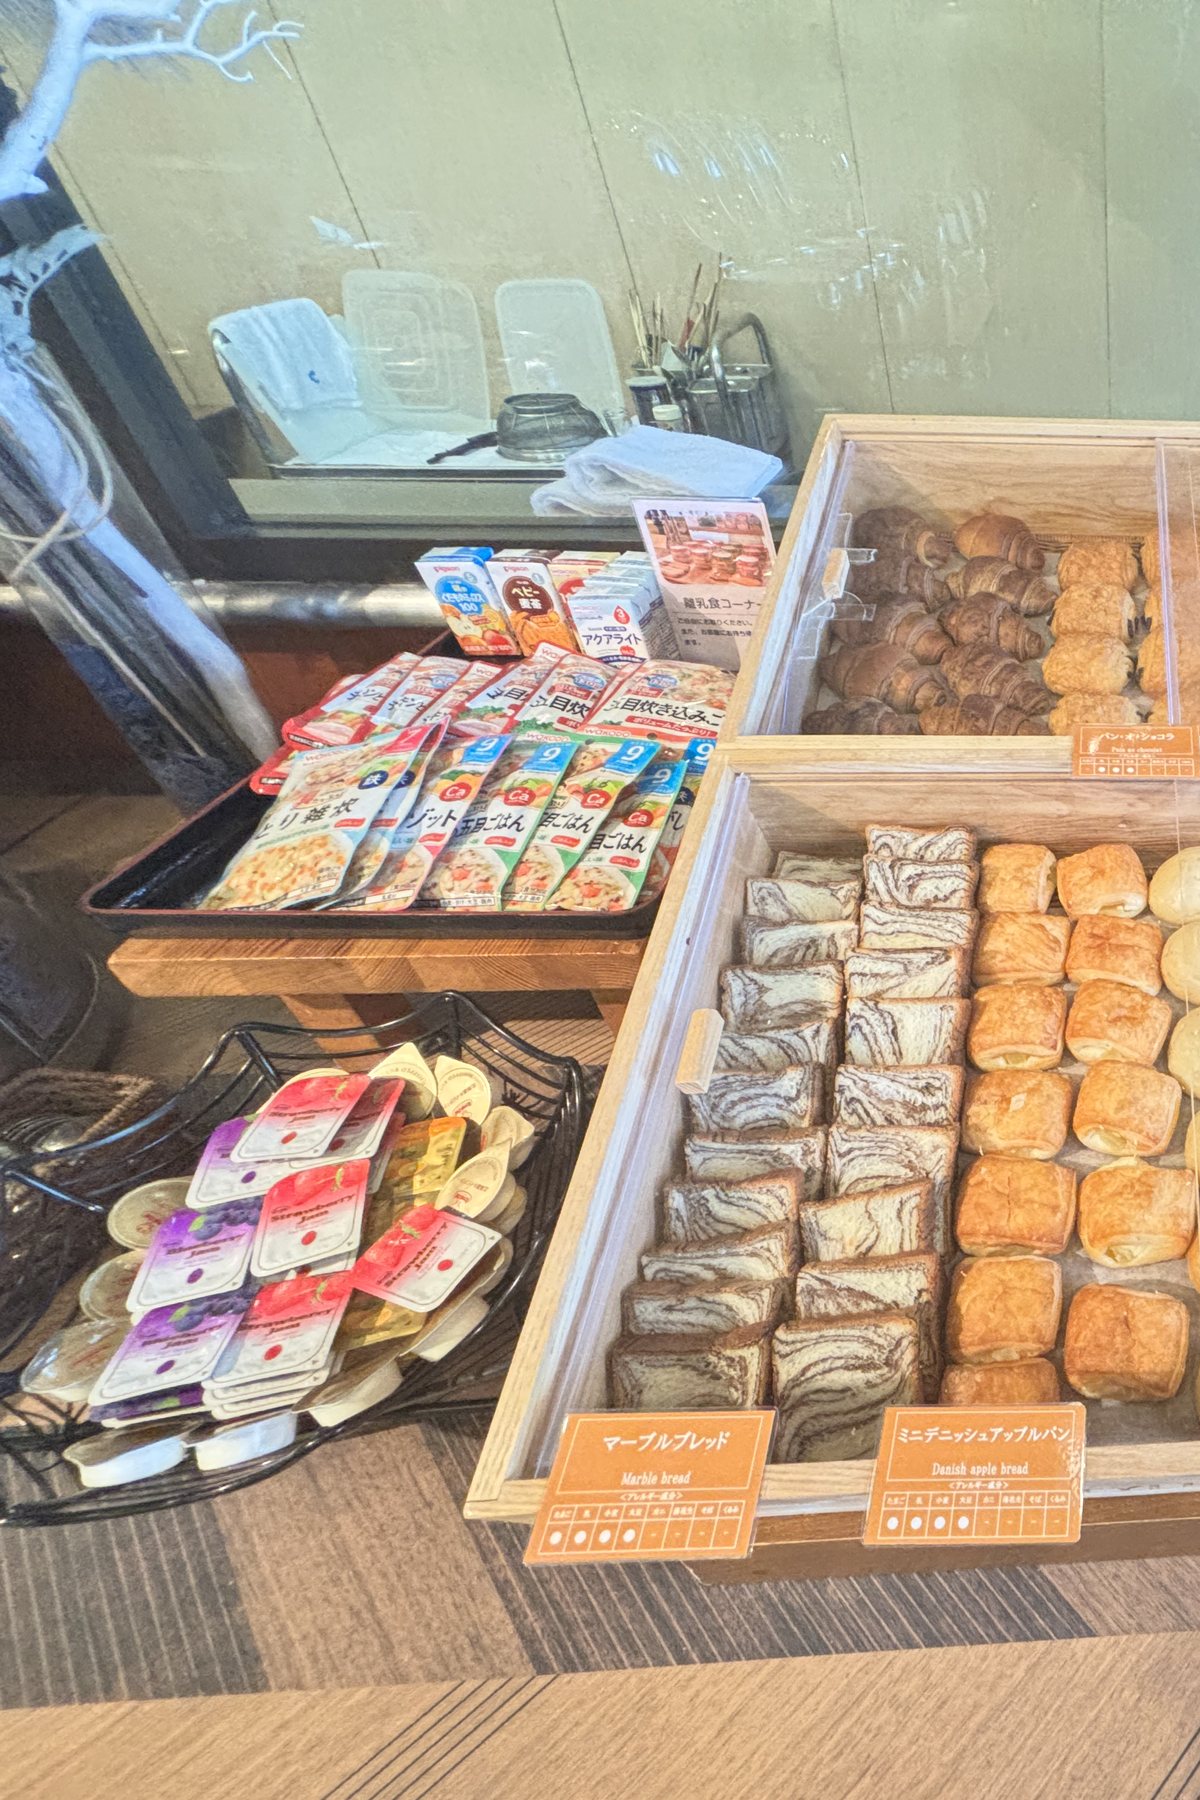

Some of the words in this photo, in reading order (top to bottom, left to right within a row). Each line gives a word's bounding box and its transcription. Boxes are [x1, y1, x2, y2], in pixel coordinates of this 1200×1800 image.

[459, 602, 478, 612] 100
[582, 632, 643, 646] アクアライト
[539, 746, 561, 761] 9
[621, 745, 645, 761] 9
[652, 768, 672, 784] 9
[445, 785, 467, 797] Ca
[508, 790, 531, 801] Ca
[586, 793, 605, 804] Ca
[627, 811, 648, 823] Ca
[270, 1194, 356, 1222] Strawberry
[384, 1221, 448, 1288] Strawberry
[603, 1429, 731, 1451] マーブルブレッド
[898, 1425, 1070, 1443] ミニデニッシュアップルパン
[932, 1462, 967, 1475] Danish
[970, 1462, 997, 1477] apple
[1000, 1461, 1029, 1474] bread
[620, 1471, 657, 1486] Marble
[661, 1470, 691, 1485] bread
